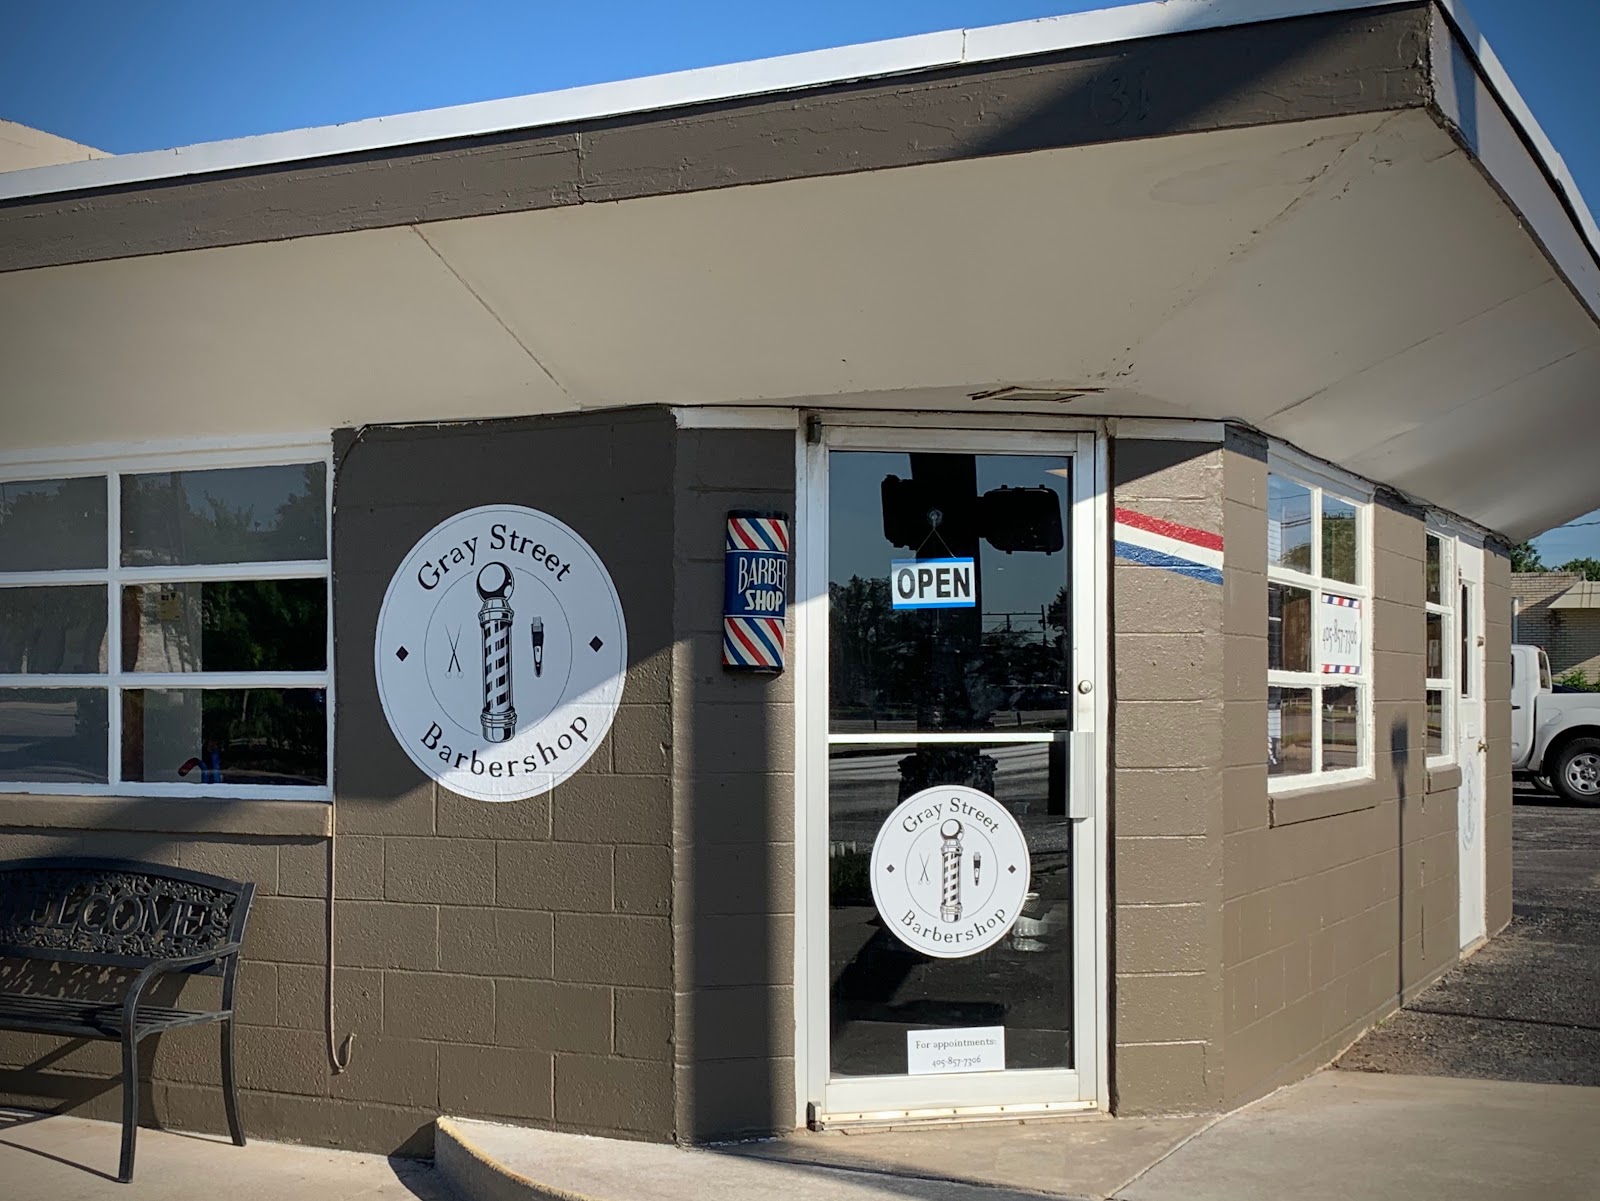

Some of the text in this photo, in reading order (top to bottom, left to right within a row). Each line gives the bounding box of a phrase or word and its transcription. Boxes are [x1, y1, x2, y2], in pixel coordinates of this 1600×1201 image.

[417, 523, 572, 591] Gray Street
[738, 556, 788, 595] BARBER
[744, 589, 784, 612] SHOP
[897, 567, 971, 600] OPEN
[420, 715, 589, 778] Barbershop
[902, 797, 999, 834] Gray Street
[900, 907, 1006, 944] Barbershop
[915, 1038, 997, 1051] For appointments:
[932, 1054, 982, 1068] 405-857-7306
